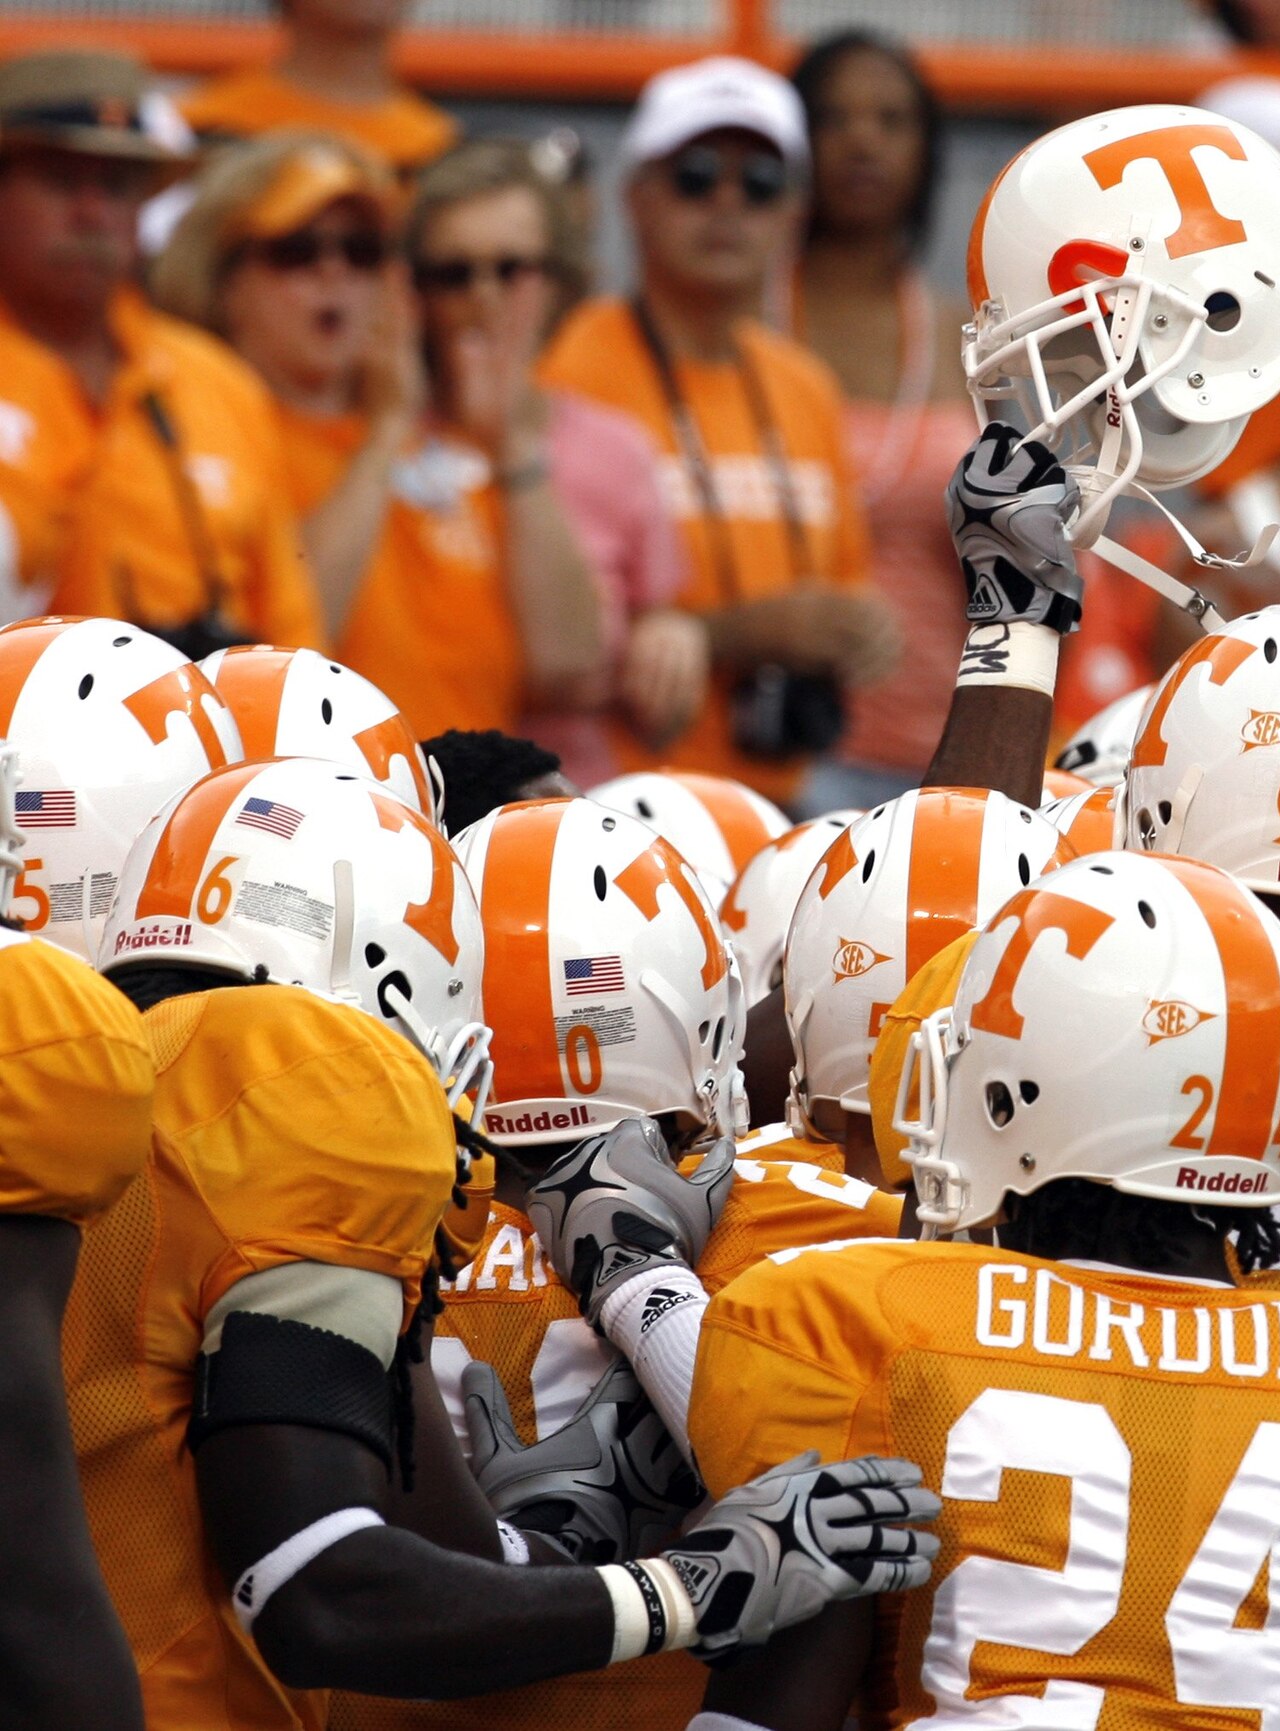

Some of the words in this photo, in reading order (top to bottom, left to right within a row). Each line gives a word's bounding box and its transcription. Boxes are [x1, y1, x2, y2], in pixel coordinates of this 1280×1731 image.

[1082, 124, 1248, 260] T
[197, 856, 240, 926] 6
[841, 945, 865, 974] SEC
[970, 889, 1117, 1041] T
[1157, 1004, 1187, 1035] SEC
[566, 1024, 602, 1096] 0
[484, 1104, 590, 1133] Riddell
[1176, 1166, 1269, 1193] Riddell
